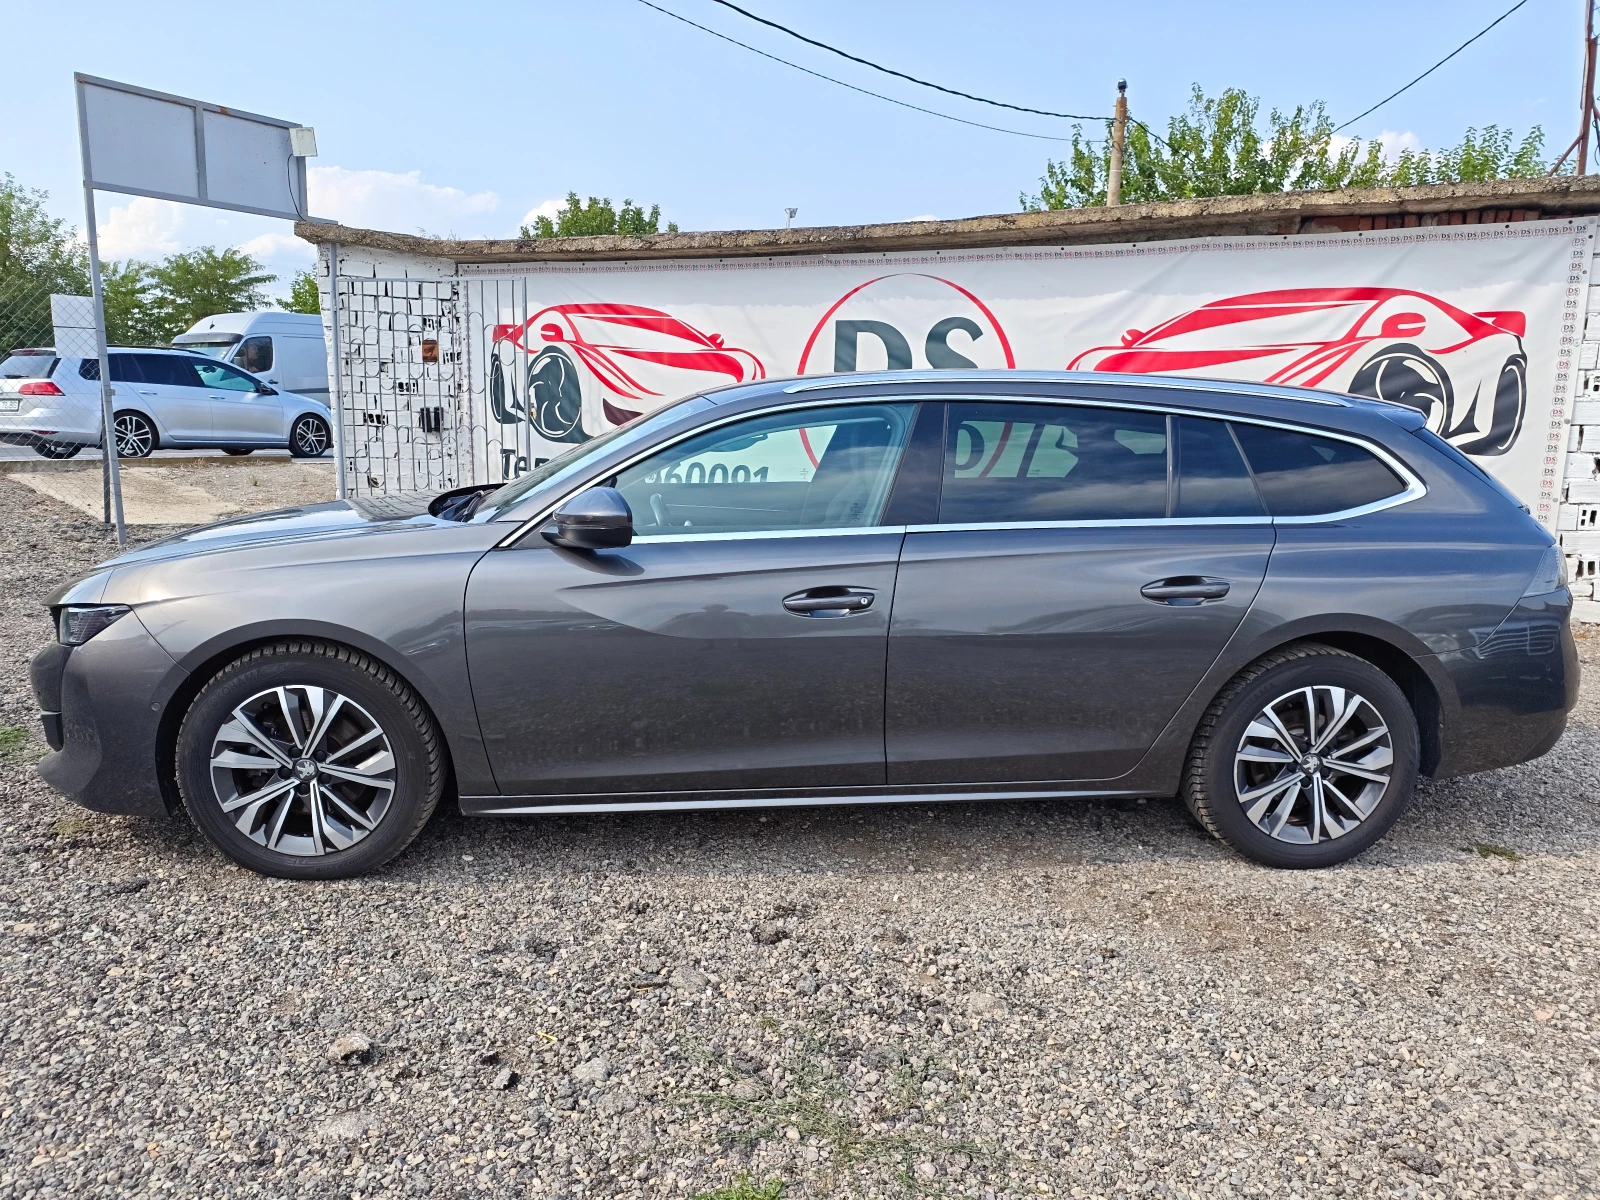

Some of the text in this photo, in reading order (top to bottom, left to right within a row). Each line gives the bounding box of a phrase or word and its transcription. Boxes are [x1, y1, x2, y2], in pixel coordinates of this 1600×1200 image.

[834, 316, 983, 372] DS
[203, 669, 263, 714] YOKOHAMA
[1229, 682, 1277, 730] YOKOHAMA
